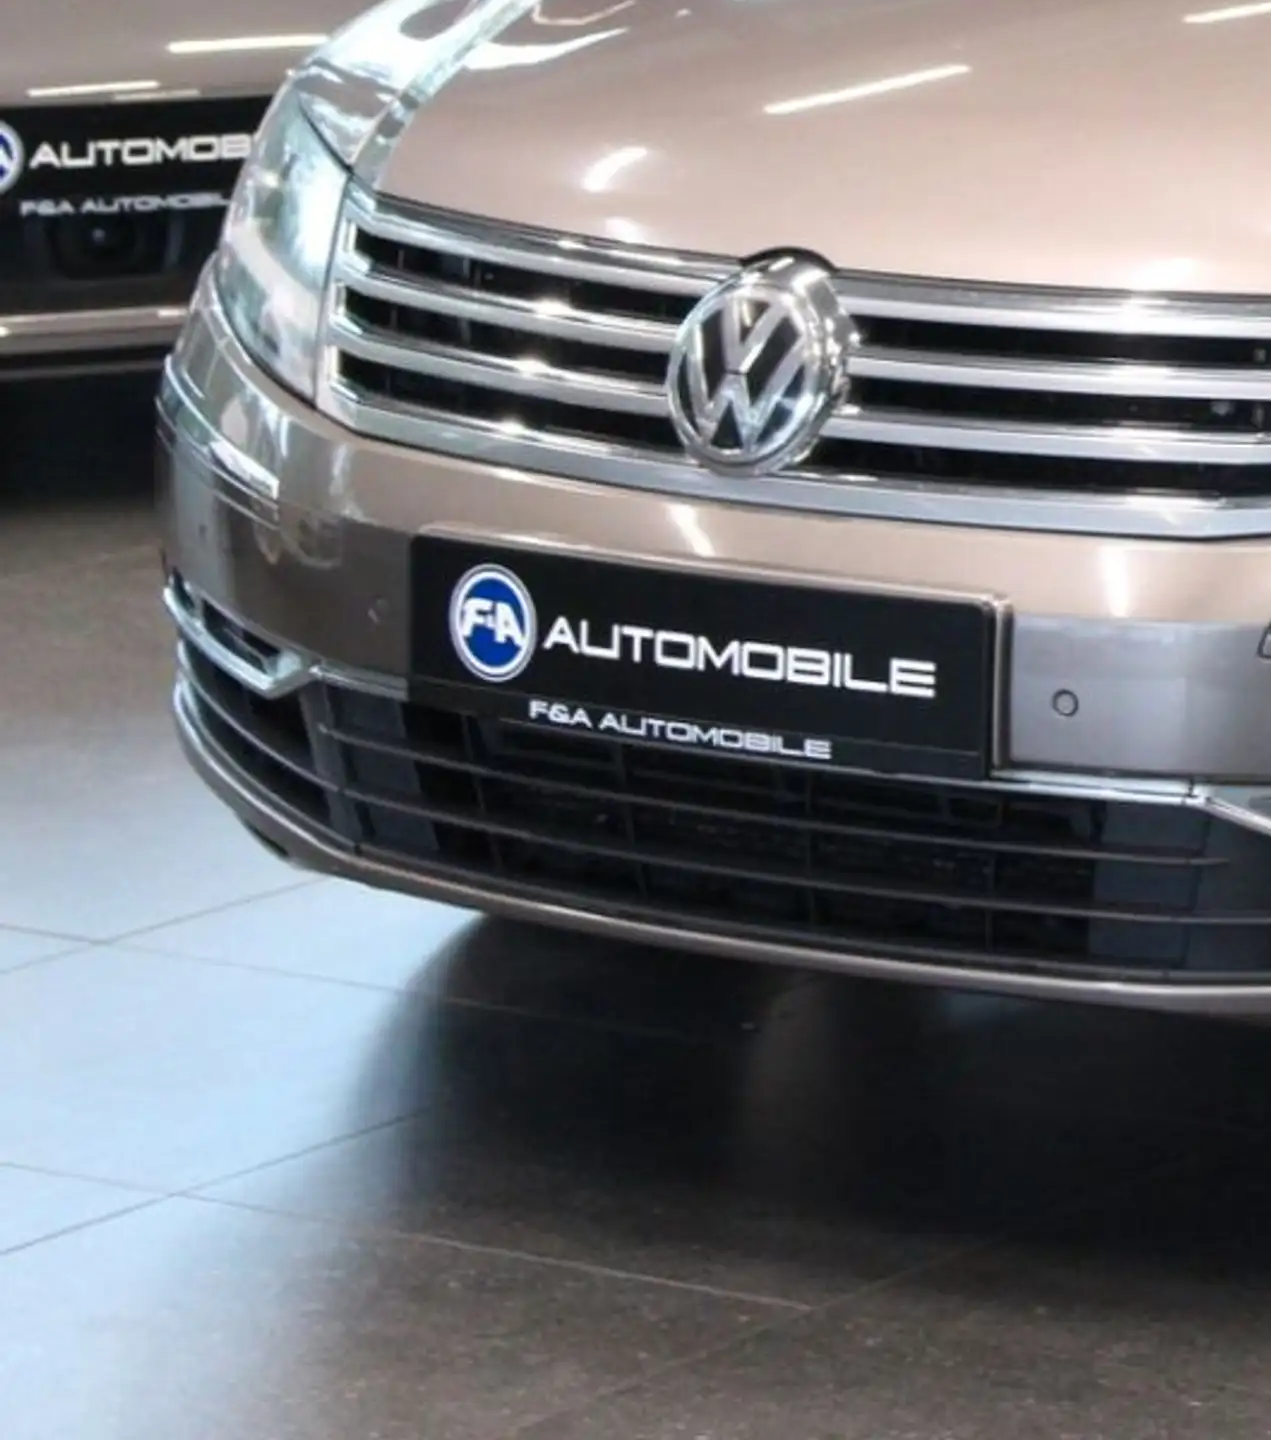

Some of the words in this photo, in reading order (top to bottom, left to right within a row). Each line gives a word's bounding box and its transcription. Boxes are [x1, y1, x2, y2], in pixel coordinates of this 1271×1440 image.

[29, 134, 251, 169] AUTOMOB
[543, 616, 936, 698] AUTOMOBILE
[529, 699, 593, 731] F&A
[599, 717, 833, 760] AUTOMOBILE
